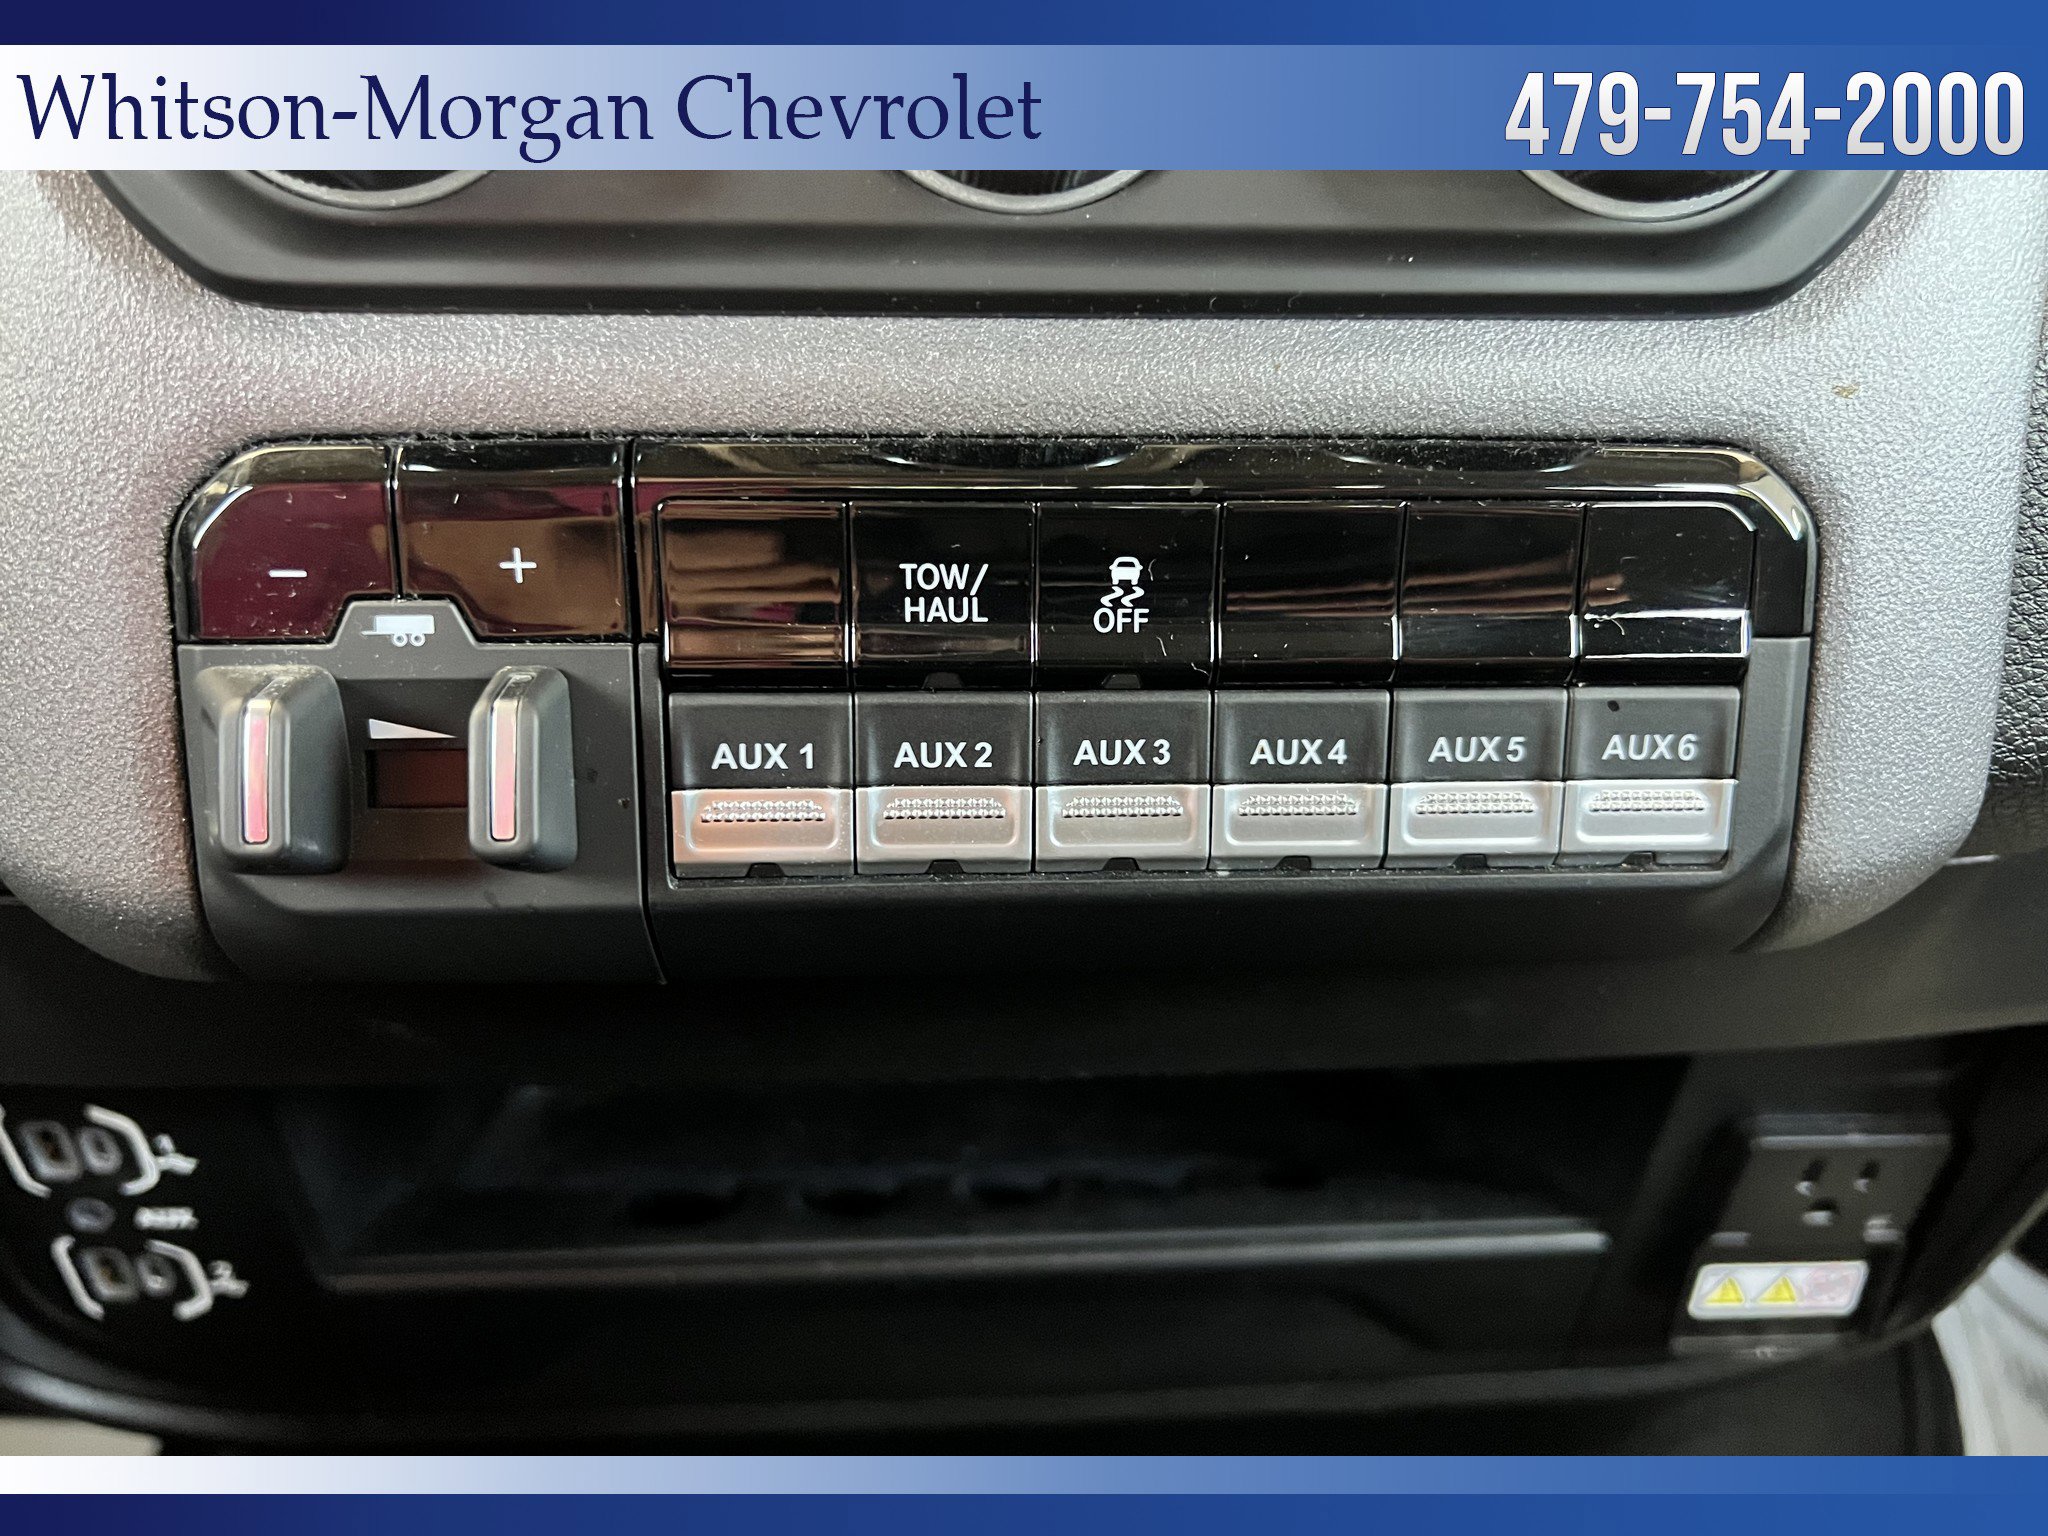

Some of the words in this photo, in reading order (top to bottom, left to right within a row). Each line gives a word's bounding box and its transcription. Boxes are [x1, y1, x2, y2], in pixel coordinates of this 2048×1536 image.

[898, 562, 989, 596] TOW/
[904, 596, 989, 623] HAUL
[1093, 607, 1150, 634] OFF
[711, 742, 789, 770] AUX
[799, 742, 814, 770] 1
[893, 741, 968, 769] AUX
[973, 741, 993, 768] 2
[1072, 738, 1147, 766] AUX
[1152, 738, 1171, 766] 3
[1249, 738, 1323, 766] AUX
[1327, 738, 1348, 765] 4
[1427, 735, 1502, 763] AUX
[1506, 736, 1527, 763] 5
[1601, 733, 1676, 761] AUX
[1678, 733, 1700, 762] 6
